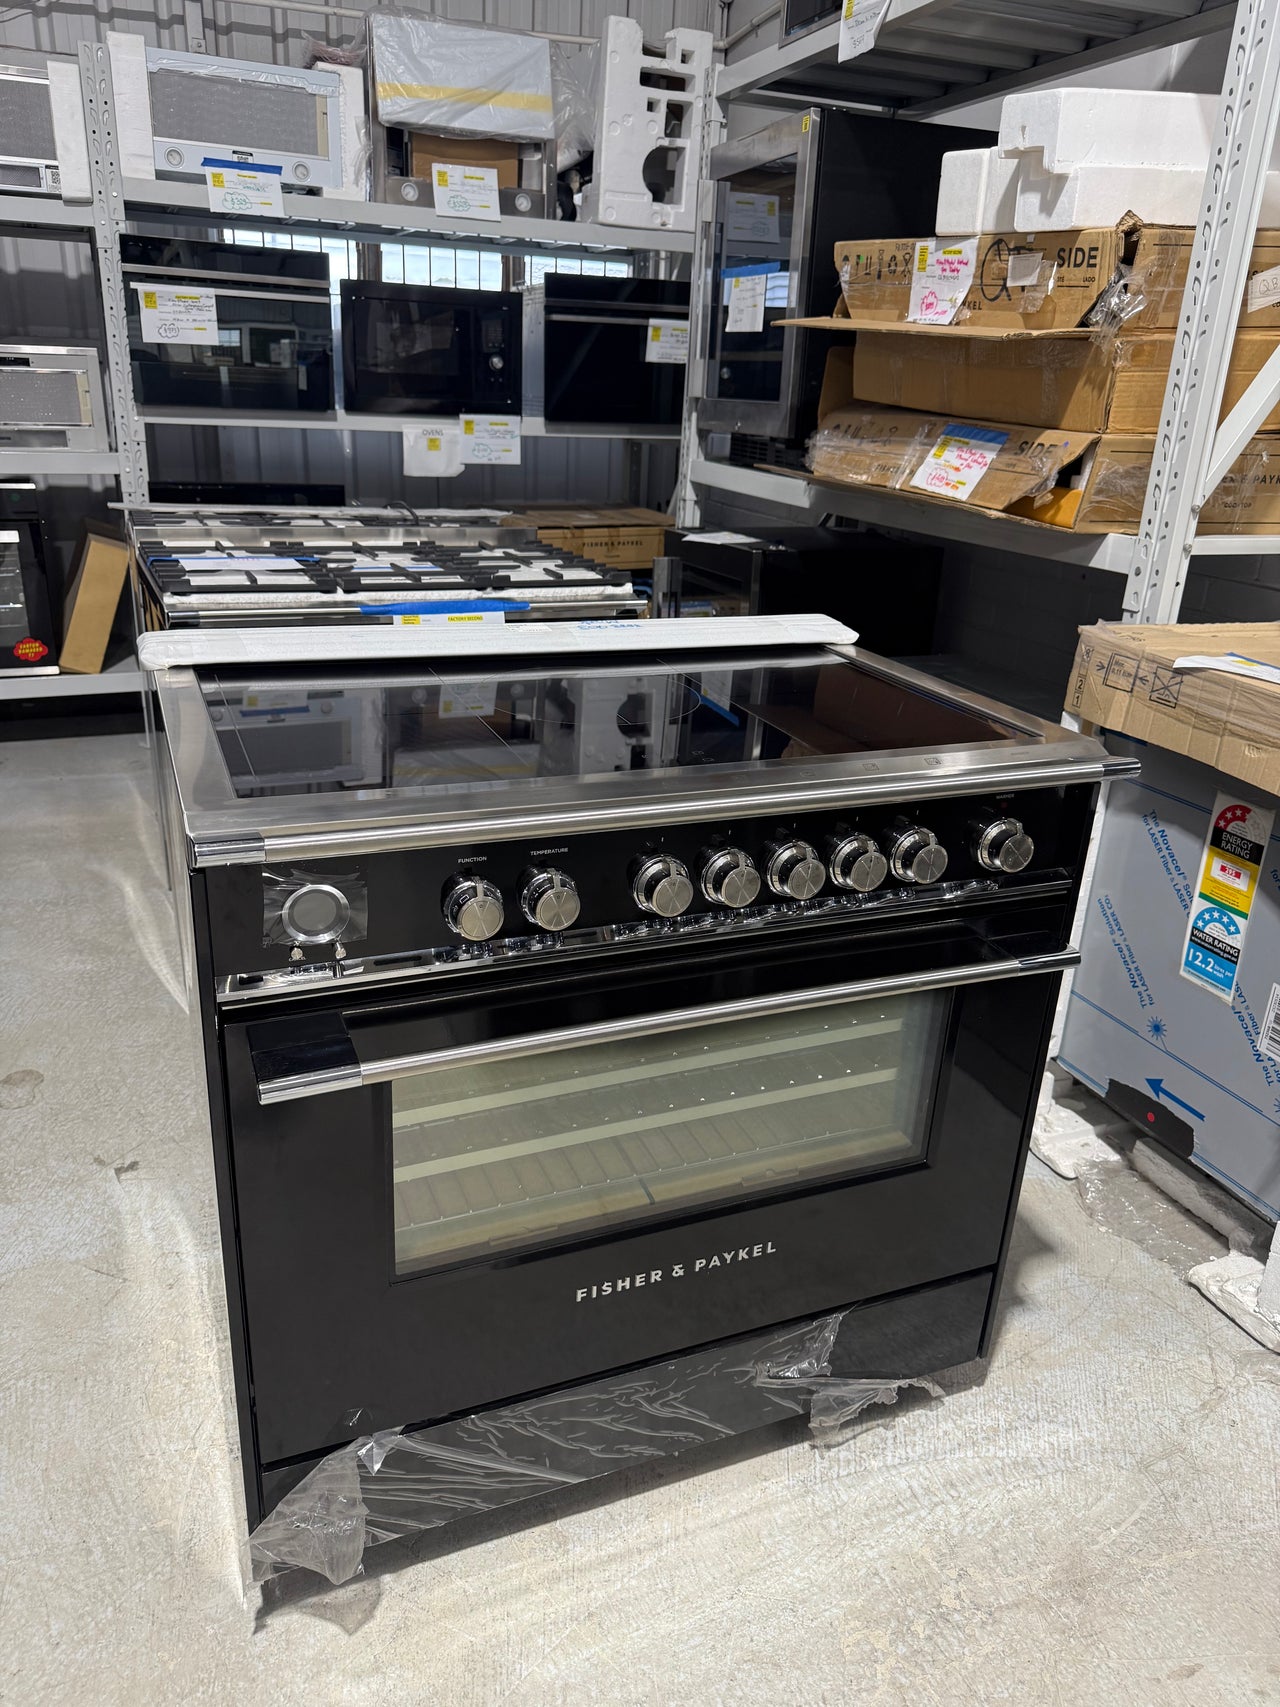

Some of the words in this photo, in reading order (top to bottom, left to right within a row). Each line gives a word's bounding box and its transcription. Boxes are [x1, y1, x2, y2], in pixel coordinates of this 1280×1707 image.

[1057, 246, 1099, 269] SIDE
[422, 428, 444, 437] OVENS
[1150, 809, 1160, 828] The
[530, 847, 569, 856] TEMPERATURE
[1220, 840, 1250, 859] RATING
[1221, 831, 1253, 851] ENERGY
[458, 856, 487, 864] FUNCTION
[1142, 814, 1150, 827] for
[1147, 827, 1163, 854] LASER
[1160, 854, 1172, 876] Fiber
[1173, 883, 1189, 911] LASER
[1225, 867, 1236, 878] 295
[1097, 898, 1116, 936] Solution
[1110, 910, 1125, 937] LASER
[1192, 928, 1213, 944] WATER
[1213, 939, 1239, 957] RATING
[1124, 943, 1137, 964] Fiber
[1188, 948, 1214, 973] 12.2
[1133, 965, 1149, 992] LASER
[1137, 991, 1147, 1009] The
[1146, 993, 1155, 1006] for
[1247, 1011, 1261, 1036] Fiber
[1262, 1065, 1274, 1086] The
[576, 1269, 663, 1302] FISHER
[671, 1263, 685, 1278] &
[695, 1241, 777, 1272] PAYKEL
